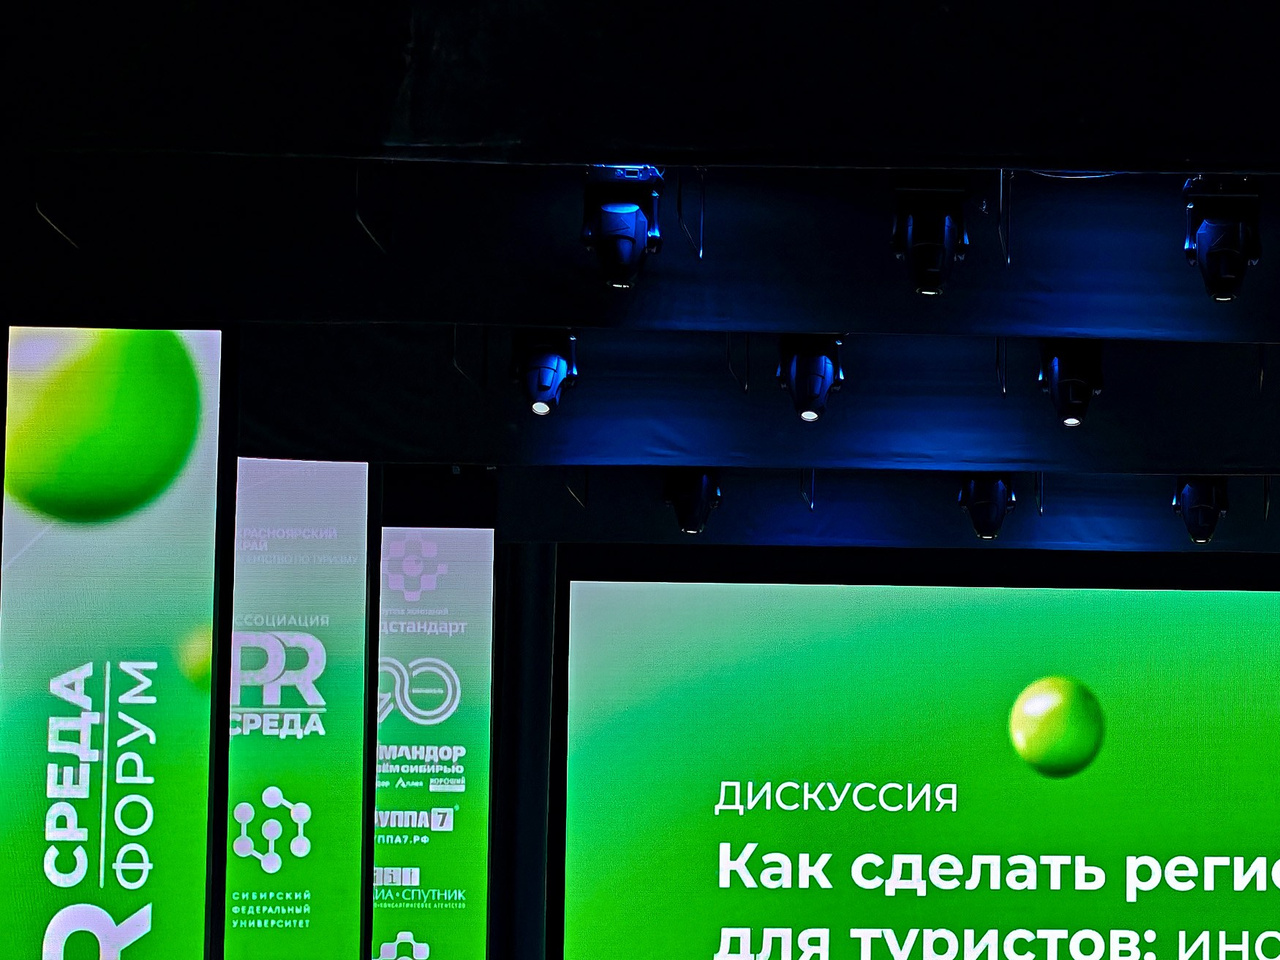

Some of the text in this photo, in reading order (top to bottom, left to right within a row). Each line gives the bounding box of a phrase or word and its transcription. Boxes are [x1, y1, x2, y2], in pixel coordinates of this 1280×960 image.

[235, 614, 329, 627] ССОЦИАЦИЯ
[380, 620, 467, 637] дстандарт
[231, 631, 327, 706] PR
[230, 714, 326, 739] СРЕДА
[378, 745, 466, 763] МАНДОР
[43, 661, 100, 888] СРЕДА
[112, 661, 158, 890] ФОРУМ
[714, 780, 958, 815] ДИСКУССИЯ
[375, 811, 430, 828] УППА
[375, 835, 430, 844] ППА7.РФ
[719, 842, 833, 889] Как
[851, 852, 1106, 896] сделать
[232, 891, 311, 901] СИБИРСКИЙ
[231, 904, 311, 915] ФЕДЕРАЛЬНЫЙ
[232, 919, 310, 928] УНИВЕРСИТЕТ
